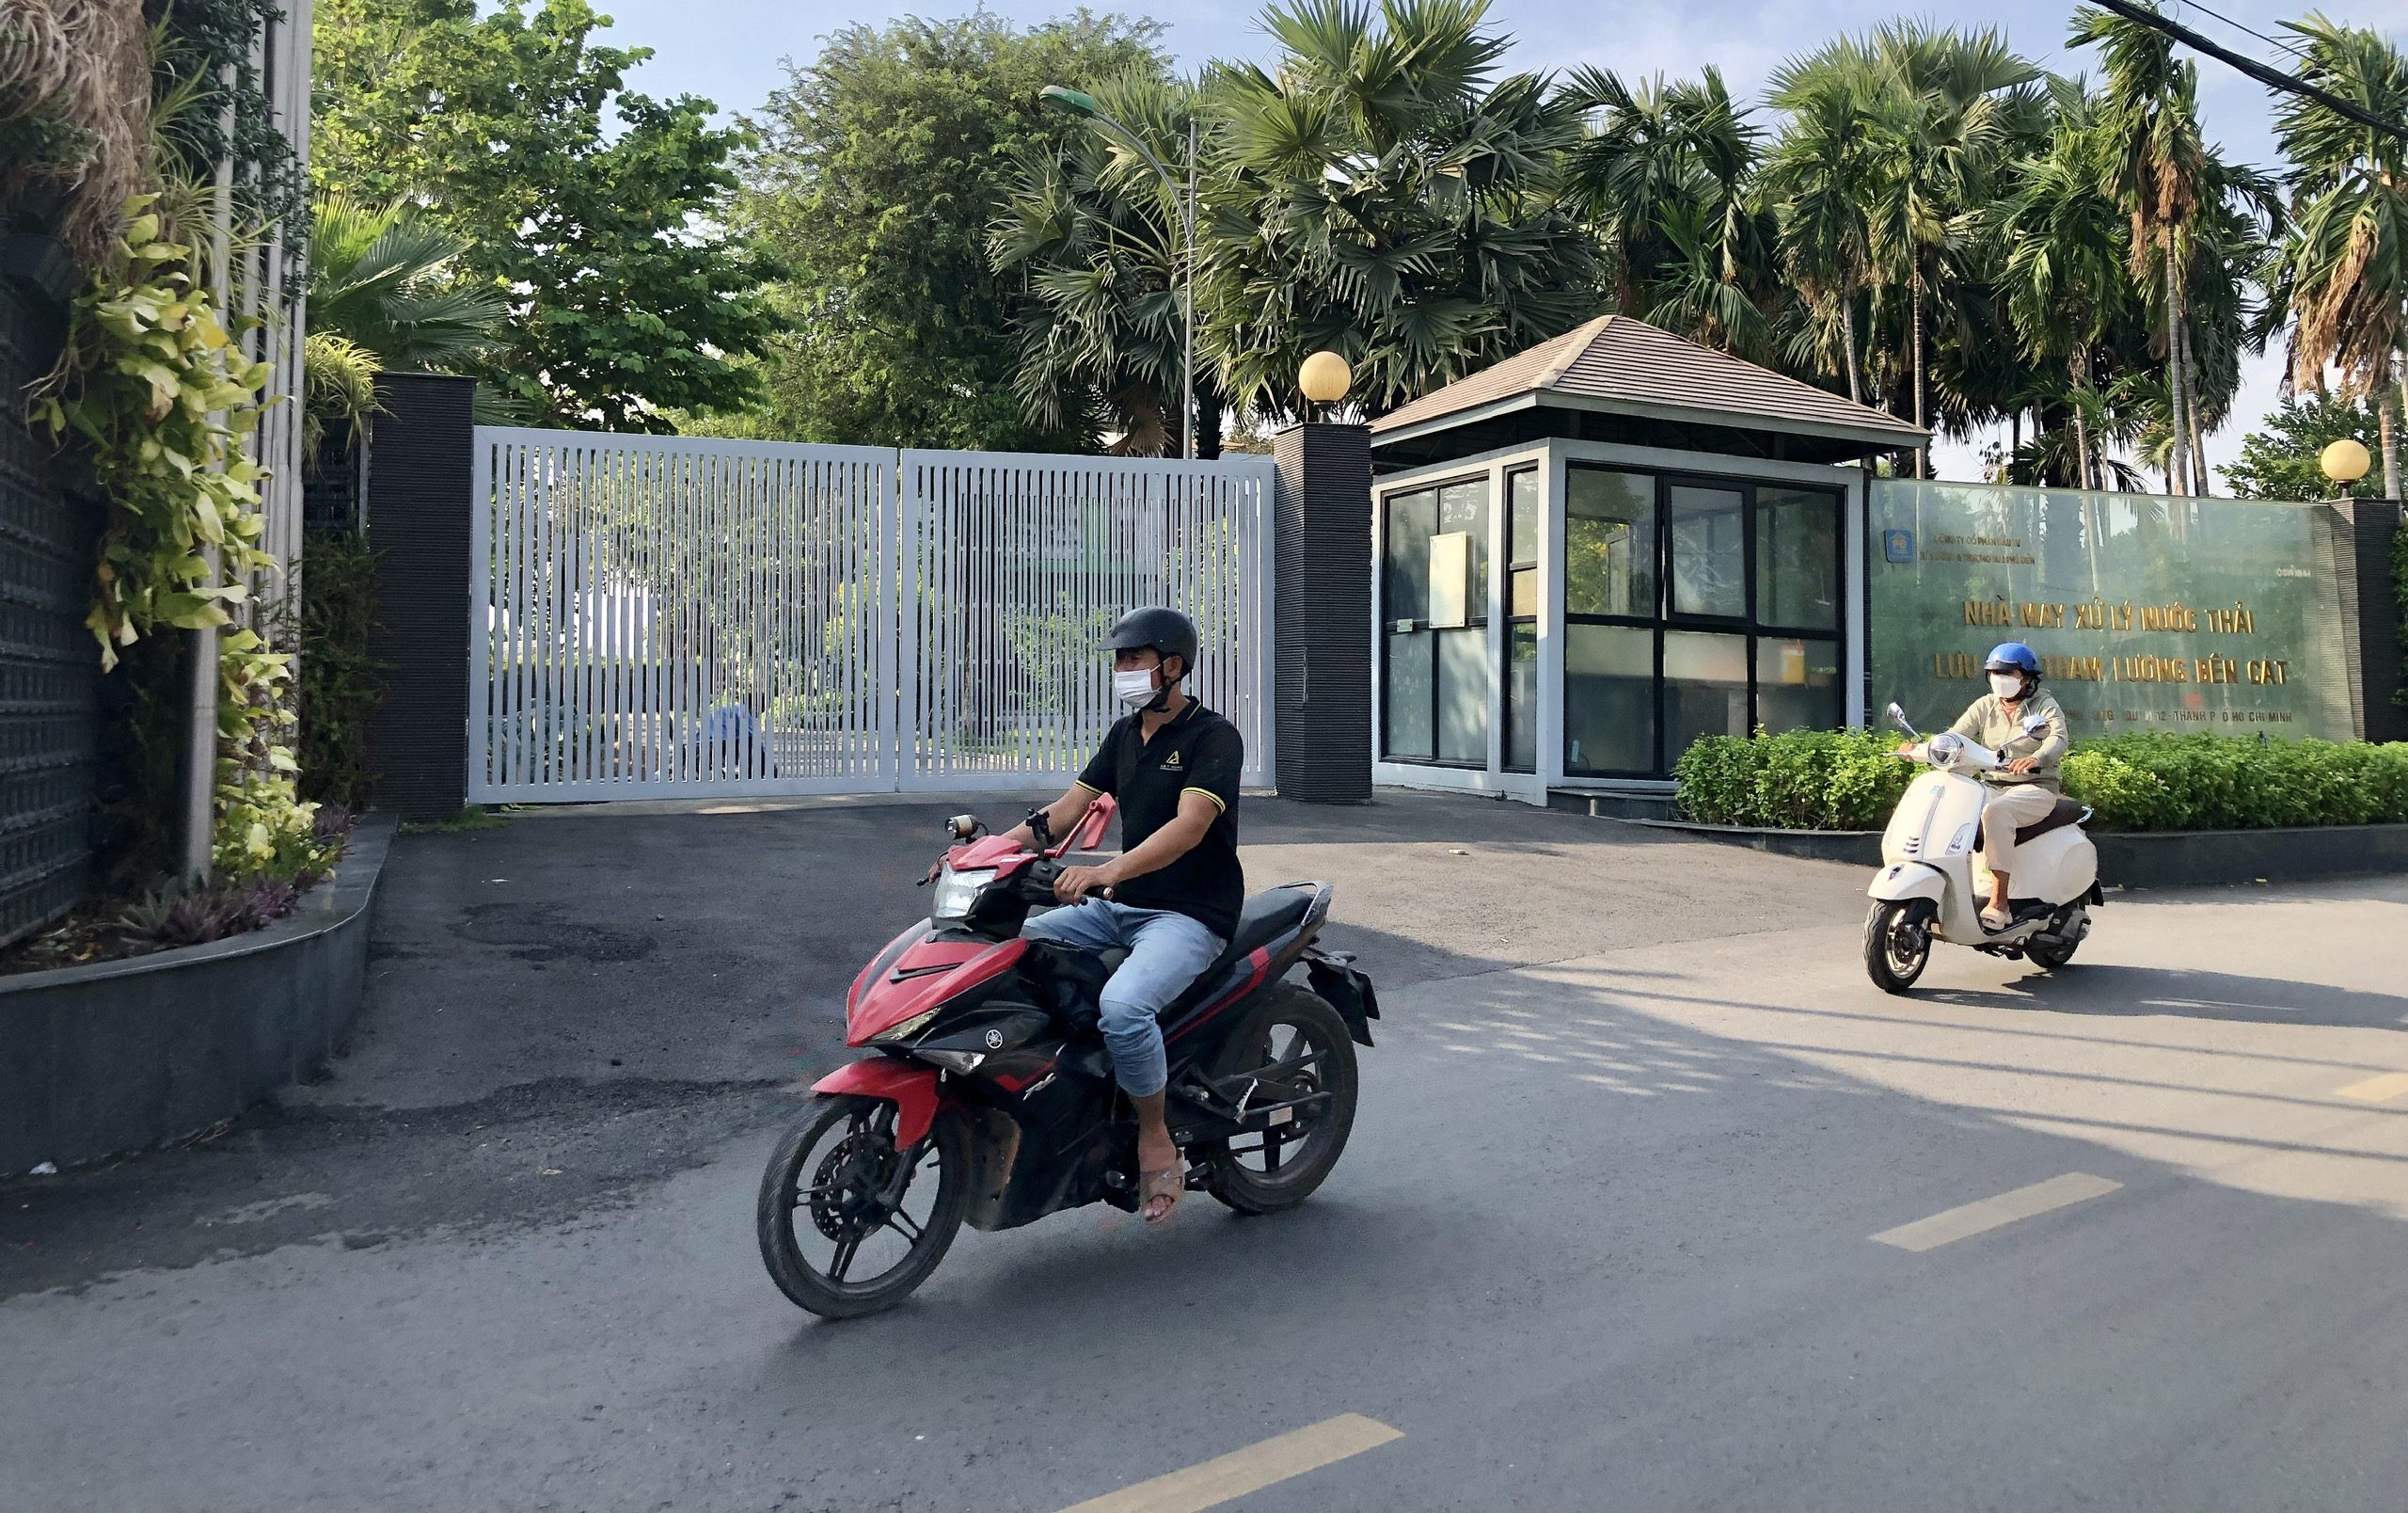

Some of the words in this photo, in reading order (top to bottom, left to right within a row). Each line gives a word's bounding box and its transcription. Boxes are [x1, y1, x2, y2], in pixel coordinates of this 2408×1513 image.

[1964, 594, 2011, 628] NHÀ
[2075, 596, 2104, 630] XỬ
[2110, 599, 2133, 631] LÝ
[2204, 600, 2255, 634] THẢI
[2194, 652, 2238, 684] BẾN
[2246, 654, 2288, 685] CÁT
[2174, 708, 2207, 722] THÀNH
[2268, 711, 2292, 723] MINH
